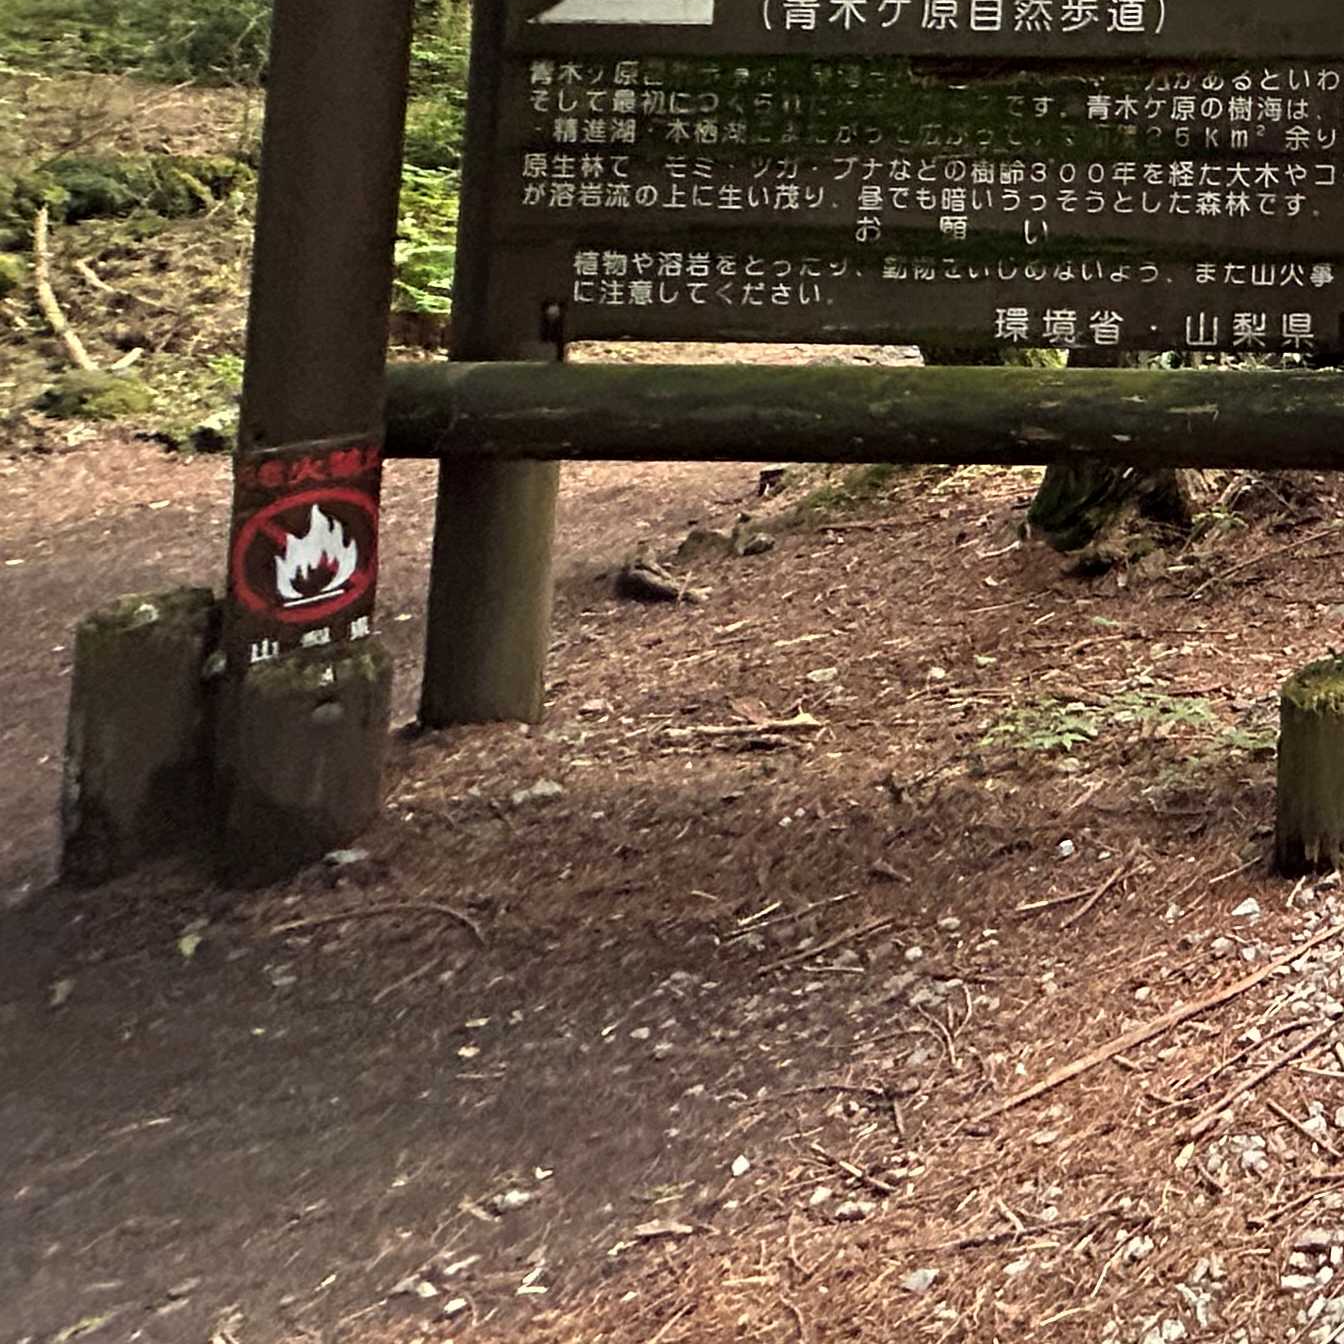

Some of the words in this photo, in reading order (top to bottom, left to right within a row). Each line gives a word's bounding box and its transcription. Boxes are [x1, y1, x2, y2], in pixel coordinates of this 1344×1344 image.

[573, 278, 835, 307] に注意してください。
[994, 306, 1315, 349] 環境省・山梨県
